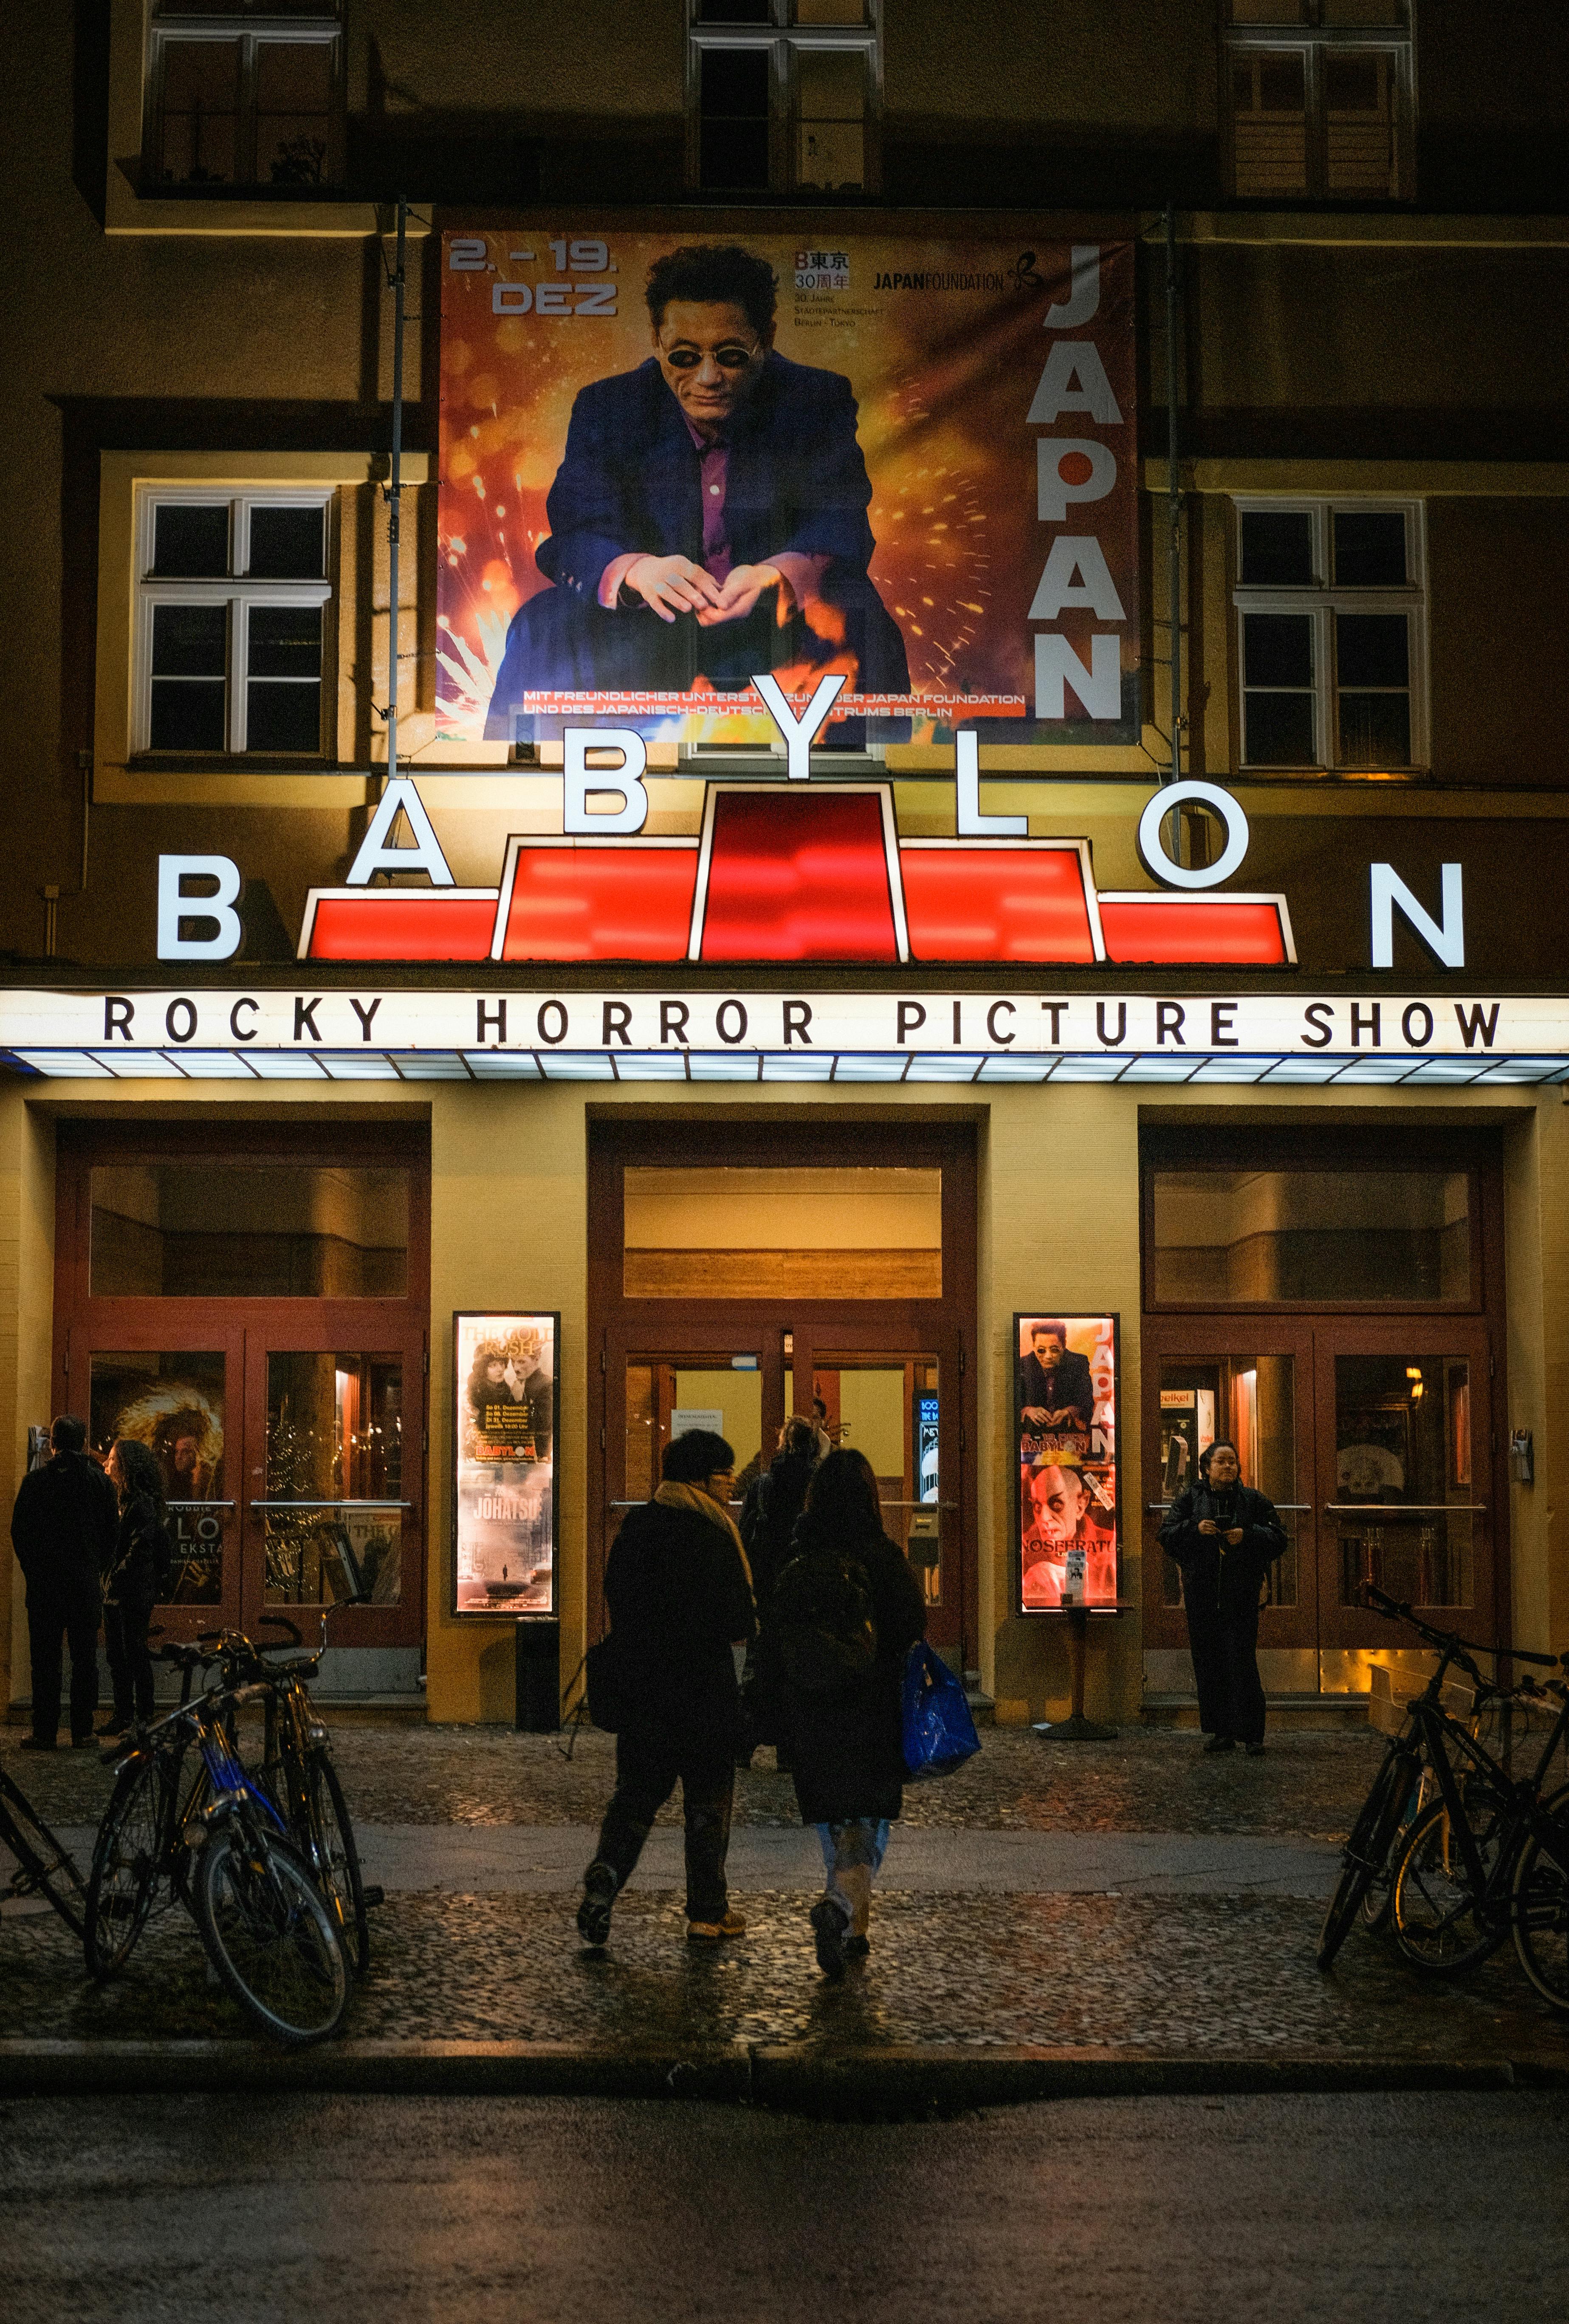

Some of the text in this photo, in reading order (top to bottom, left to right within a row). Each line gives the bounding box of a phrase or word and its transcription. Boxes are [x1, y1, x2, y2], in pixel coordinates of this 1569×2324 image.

[449, 238, 496, 271] 2.
[549, 239, 619, 272] 19.
[492, 283, 617, 316] DEZ
[1025, 246, 1127, 719] JAPAN
[523, 691, 552, 701] MIT
[554, 691, 679, 701] FREUNDLICHER
[867, 694, 920, 704] JAPAN
[923, 695, 1025, 704] FOUNDATION
[523, 704, 559, 714] UND
[562, 705, 594, 714] DES
[894, 707, 952, 717] BERLIN
[155, 675, 1465, 970] BABYLON
[104, 996, 1501, 1048] ROCKY HORROR PICTURE SHOW
[483, 1340, 534, 1355] RUSH
[1090, 1318, 1115, 1453] JAPAN
